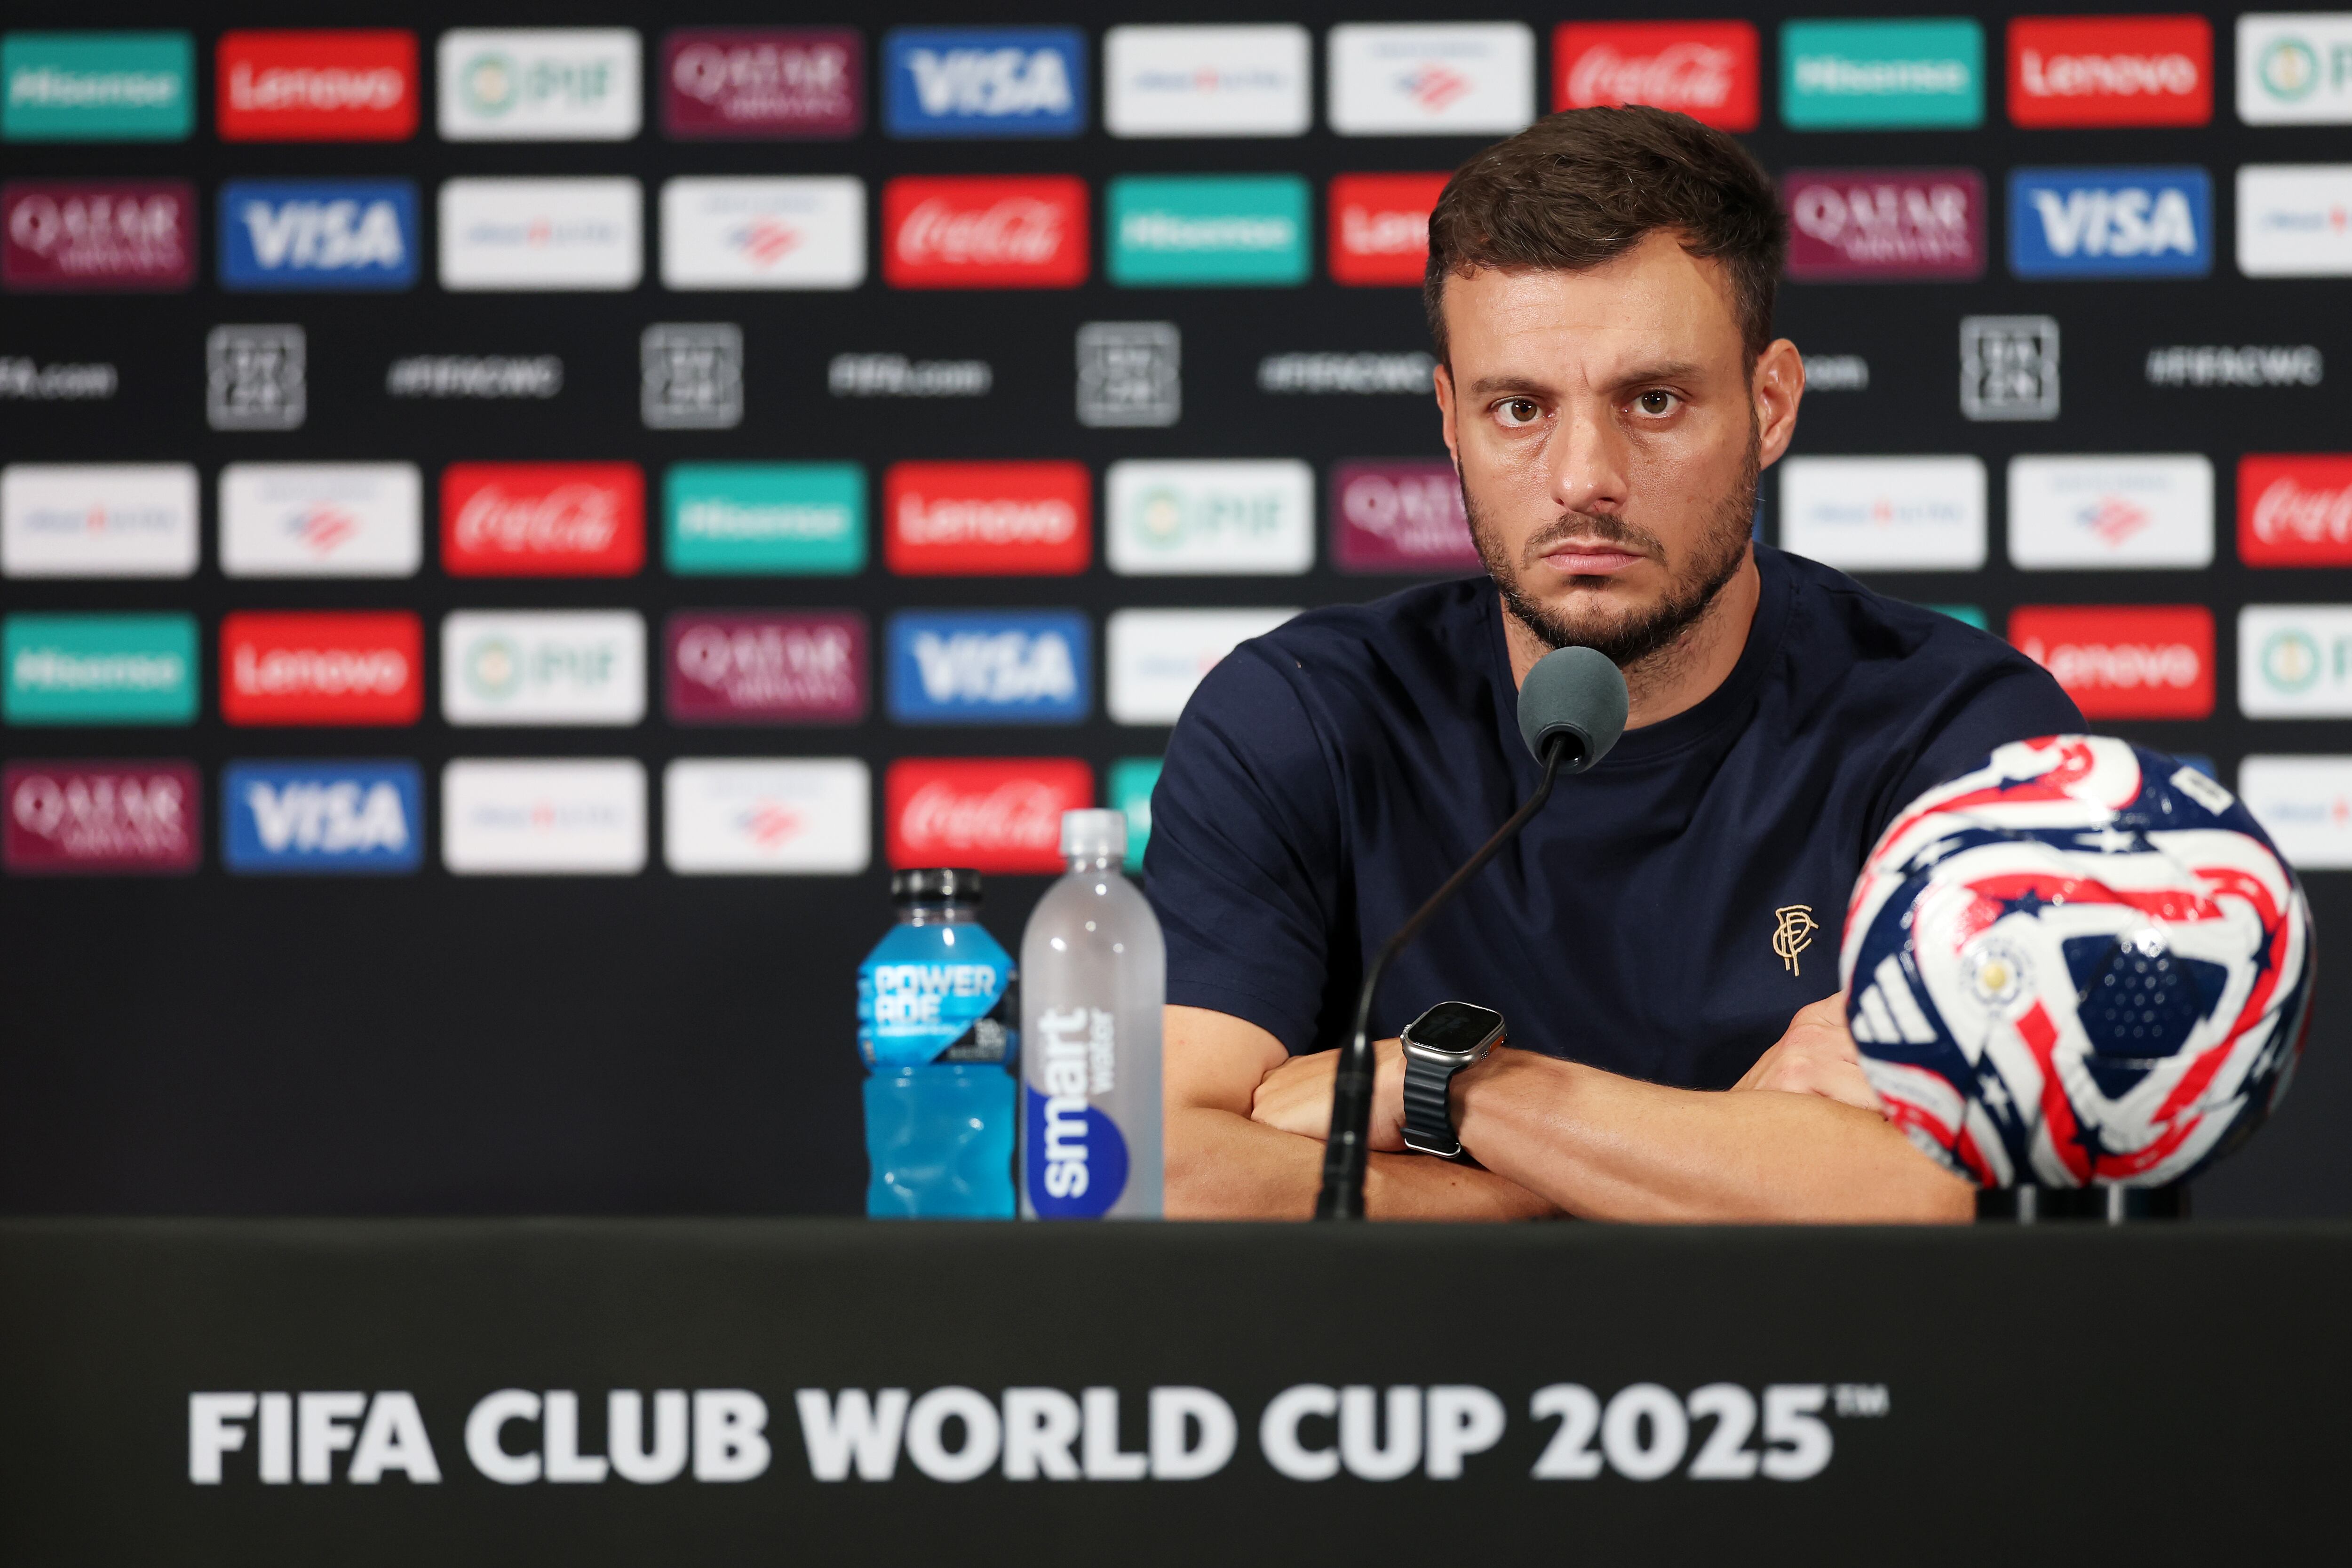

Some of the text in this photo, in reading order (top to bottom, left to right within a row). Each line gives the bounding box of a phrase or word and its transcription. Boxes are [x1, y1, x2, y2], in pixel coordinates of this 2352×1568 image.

[230, 64, 405, 111] Lenovo
[908, 48, 1073, 117] VISA
[2020, 49, 2199, 97] Lenovo
[9, 196, 180, 257] QATAR
[243, 199, 405, 270] VISA
[1342, 207, 1429, 255] Len
[1794, 186, 1968, 245] QATAR
[2032, 188, 2197, 257] VISA
[898, 494, 1077, 545] Lenovo
[234, 644, 409, 695] Lenovo
[912, 631, 1077, 704] VISA
[246, 780, 409, 853] VISA
[874, 964, 995, 996] POWER
[1090, 1008, 1115, 1095] water
[1039, 1007, 1090, 1199] smart
[188, 1390, 442, 1485] FIFA
[464, 1388, 772, 1485] CLUB
[795, 1385, 1238, 1483] WORLD
[1259, 1383, 1506, 1481] CUP
